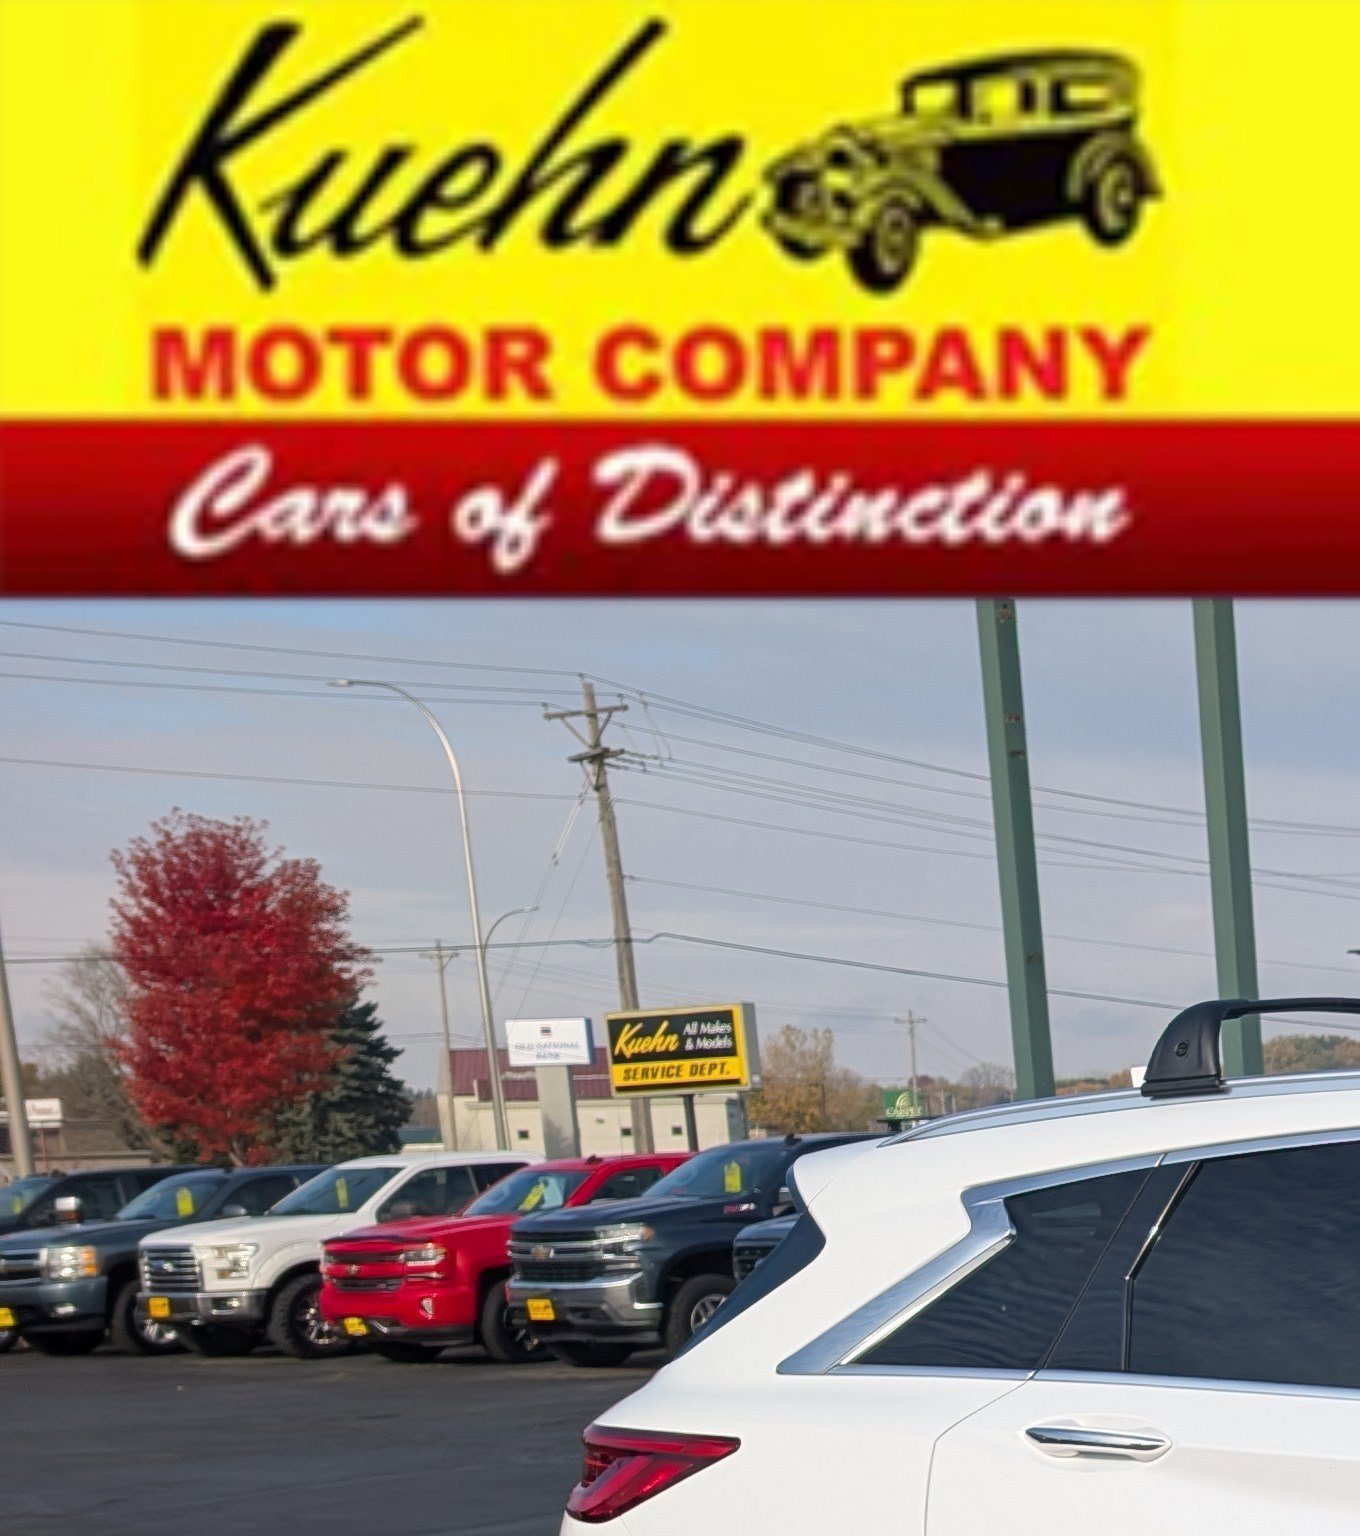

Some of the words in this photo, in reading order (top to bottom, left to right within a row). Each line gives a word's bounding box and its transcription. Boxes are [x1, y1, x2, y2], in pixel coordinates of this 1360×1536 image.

[613, 1019, 680, 1059] Kuehn
[683, 1021, 698, 1036] All
[700, 1019, 732, 1034] Makes
[684, 1037, 695, 1050] &
[695, 1035, 733, 1050] Models
[622, 1063, 683, 1082] SERVICE
[689, 1061, 730, 1077] DEPT.
